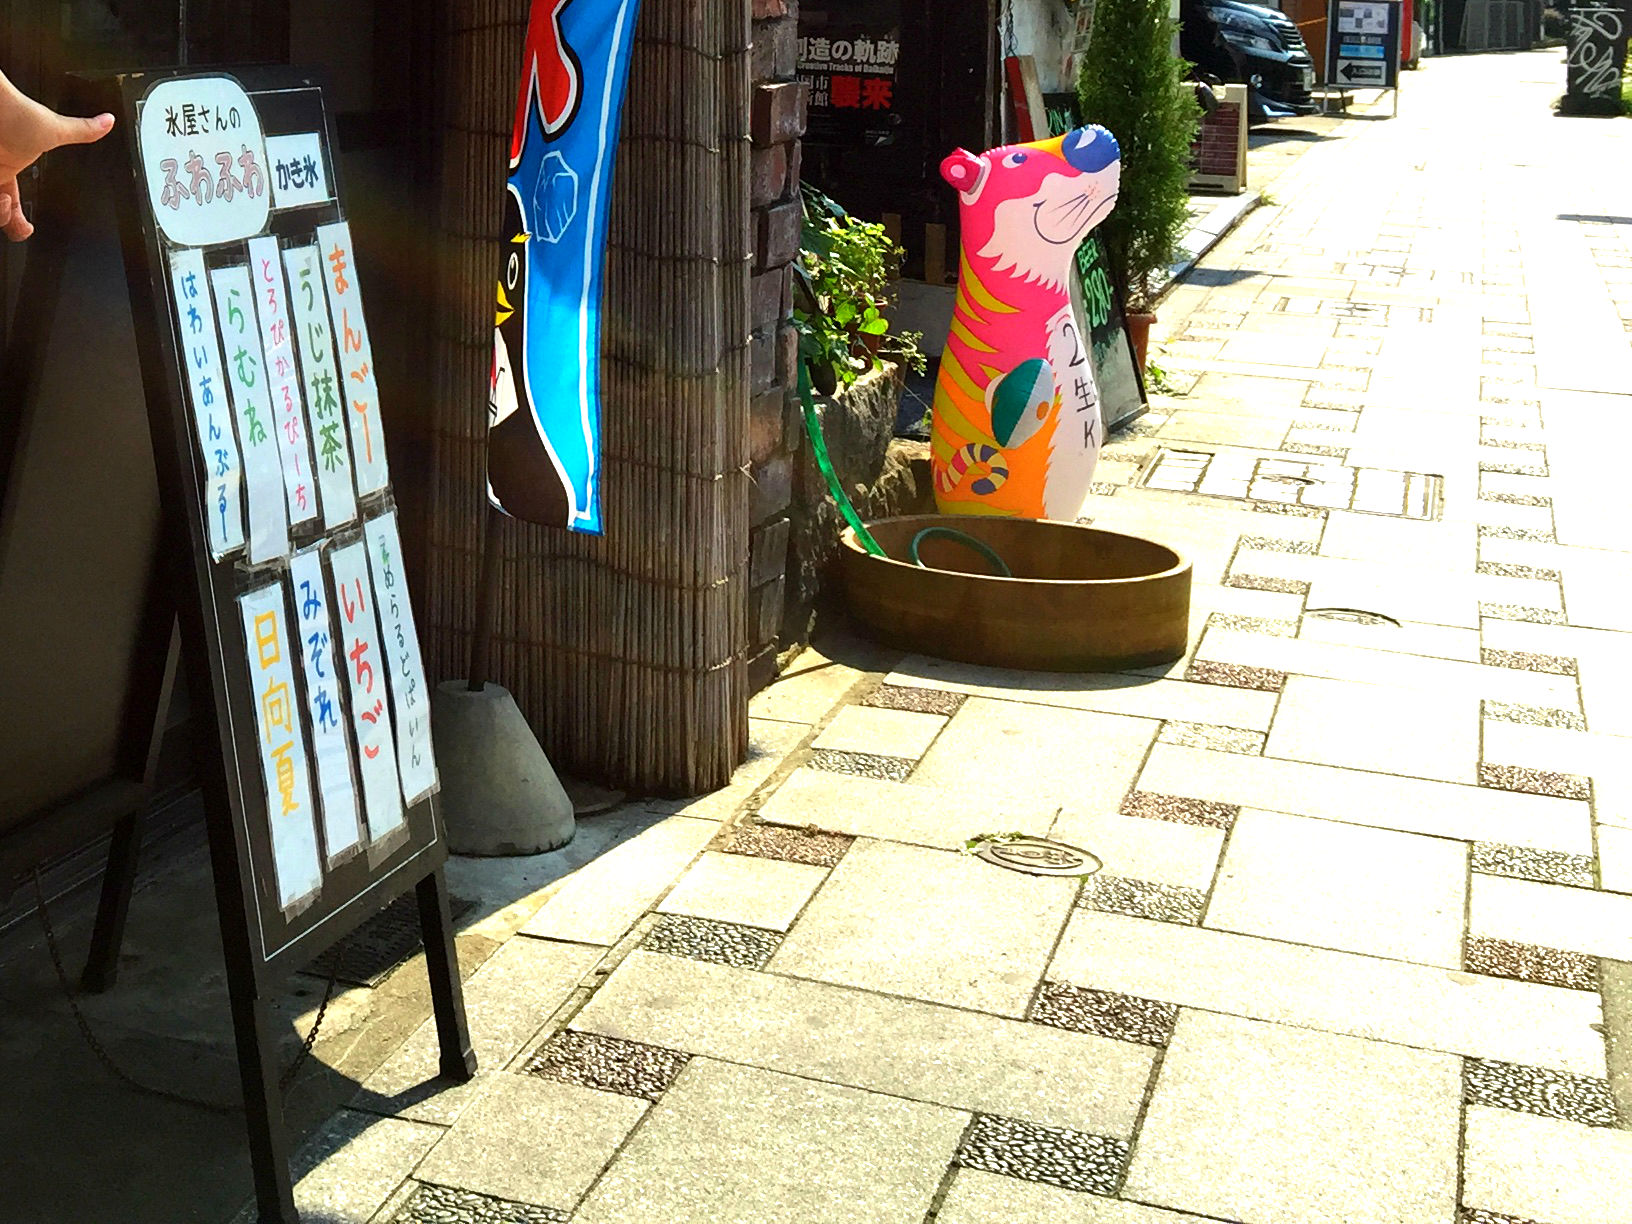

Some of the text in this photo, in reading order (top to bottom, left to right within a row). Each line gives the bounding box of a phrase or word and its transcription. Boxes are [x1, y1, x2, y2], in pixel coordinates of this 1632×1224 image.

[158, 144, 266, 210] ふわふわ
[164, 103, 242, 136] 氷屋さんの
[274, 155, 321, 192] かき氷
[831, 75, 893, 111] 襲来
[179, 274, 232, 543] はわいあんぶるー
[226, 288, 268, 448] らむね
[261, 258, 308, 512] とろぴかるぴーち
[299, 268, 345, 473] うじ抹茶
[328, 242, 375, 464] まんごー
[254, 610, 300, 817] 日向夏
[299, 579, 338, 735] みぞれ
[340, 577, 384, 760] いちご
